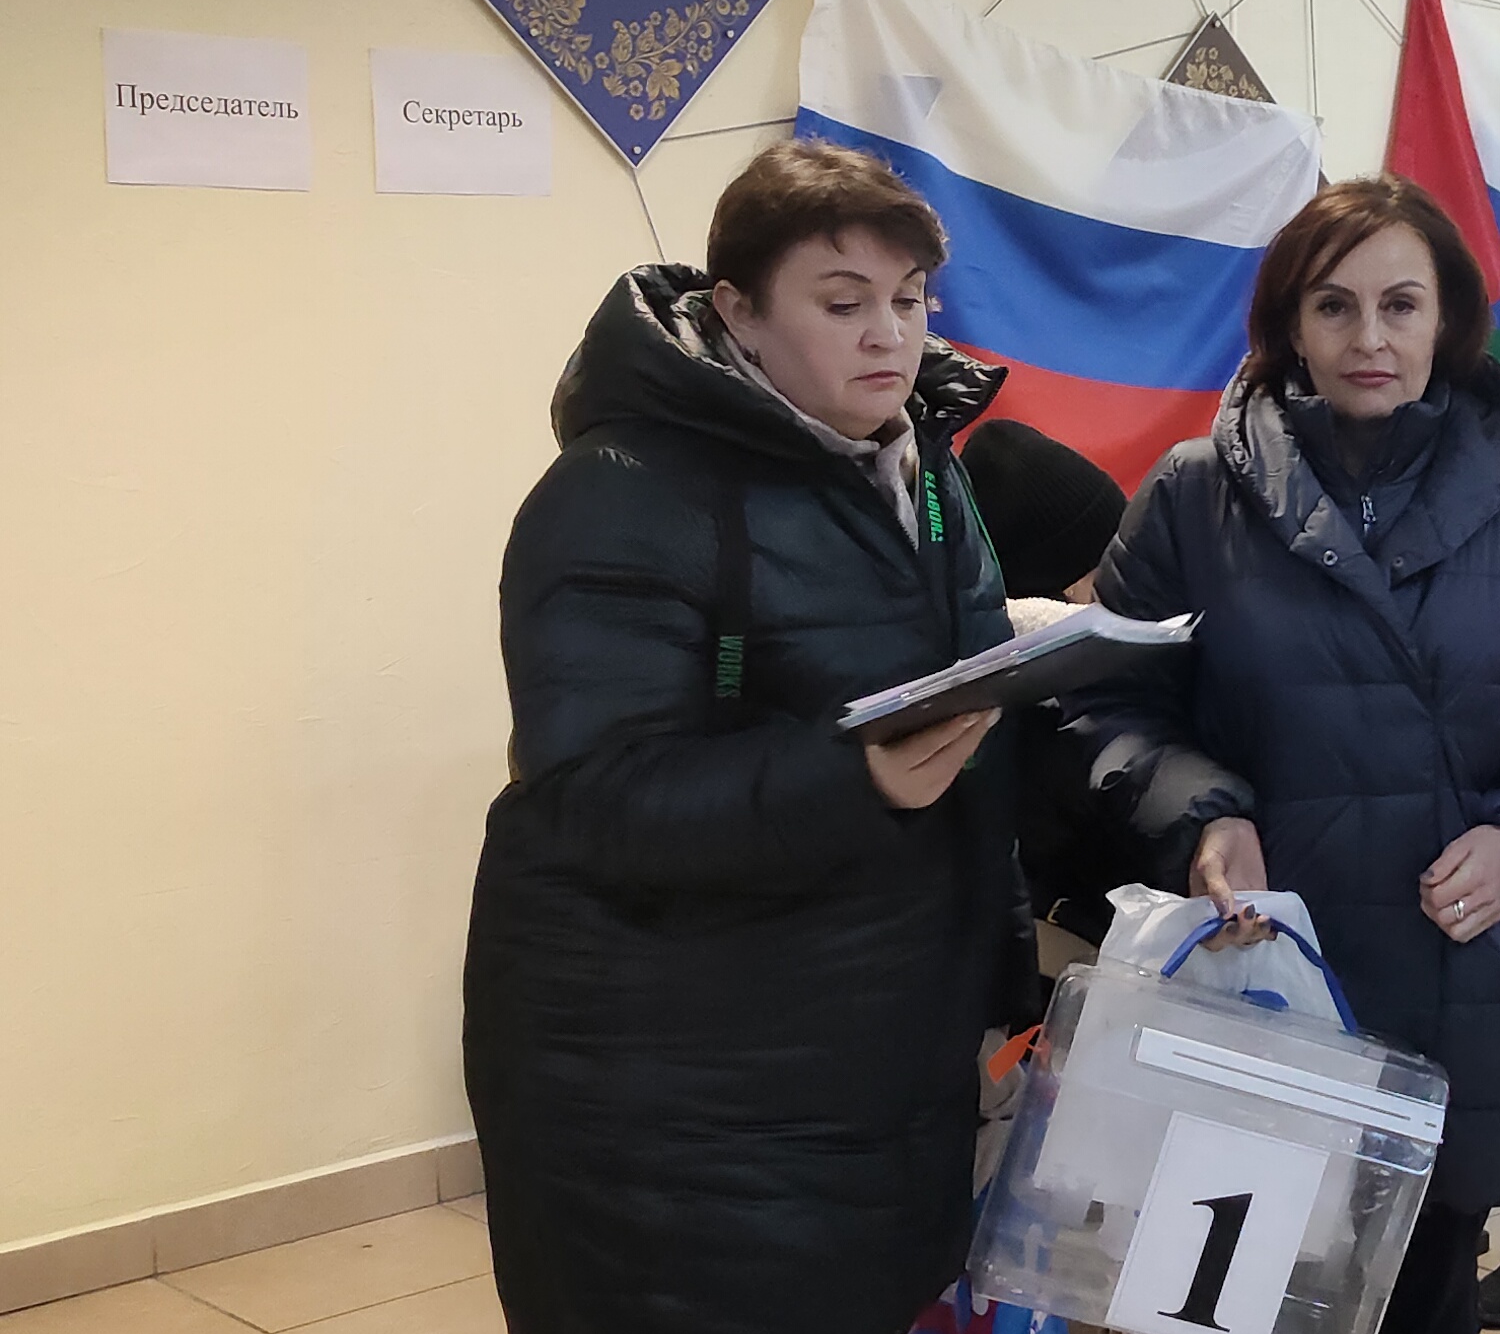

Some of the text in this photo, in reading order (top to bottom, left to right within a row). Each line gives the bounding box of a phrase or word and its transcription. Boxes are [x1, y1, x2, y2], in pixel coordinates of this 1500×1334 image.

[115, 83, 299, 120] Председатель
[402, 100, 523, 132] Секретарь
[717, 635, 744, 698] WORKS
[1156, 1192, 1254, 1333] 1
